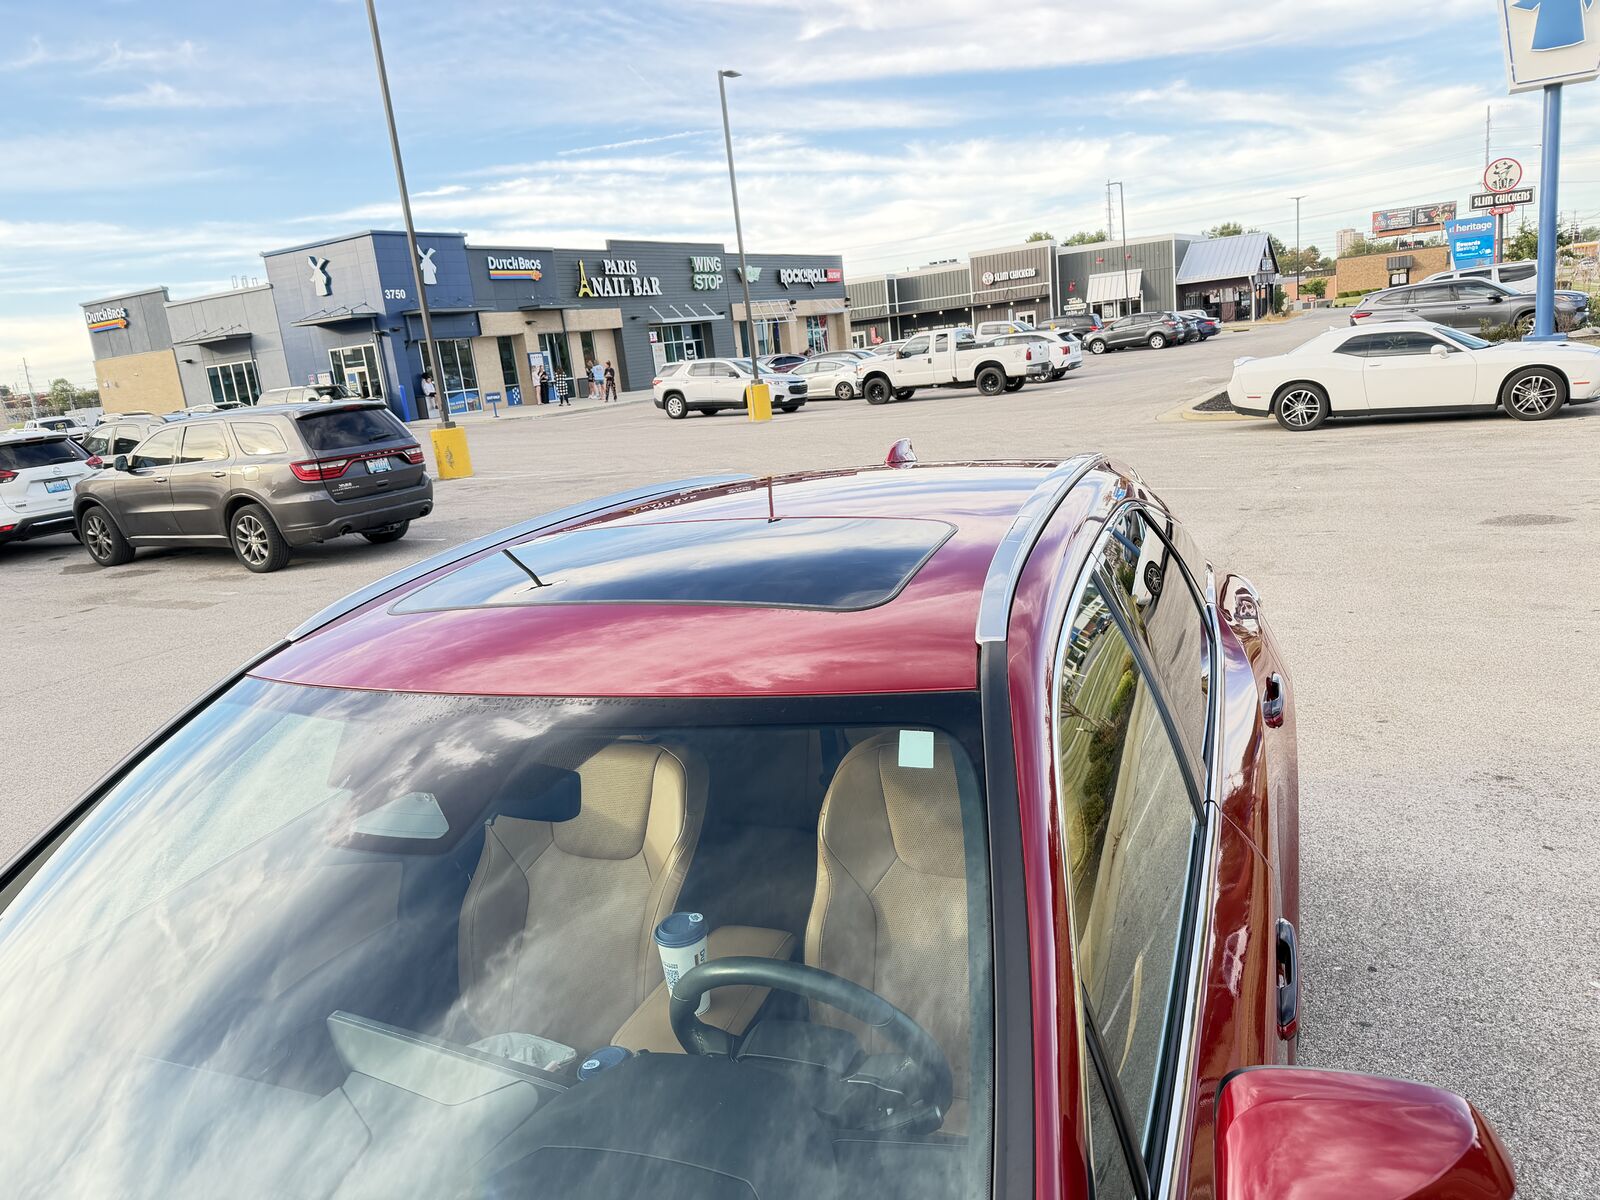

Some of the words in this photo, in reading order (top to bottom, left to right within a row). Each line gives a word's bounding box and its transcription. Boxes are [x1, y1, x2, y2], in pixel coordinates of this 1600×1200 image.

[1474, 195, 1494, 207] SLIM
[1495, 190, 1531, 205] CHICKENS
[1456, 222, 1493, 233] heritage
[518, 256, 542, 270] BROS
[602, 259, 638, 275] PARIS
[691, 256, 722, 273] WING
[694, 273, 724, 291] STOP
[994, 271, 1009, 282] SLIM
[1009, 267, 1037, 280] CHICKENS
[384, 288, 406, 300] 3750
[590, 276, 631, 297] NAIL
[631, 276, 663, 296] BAR
